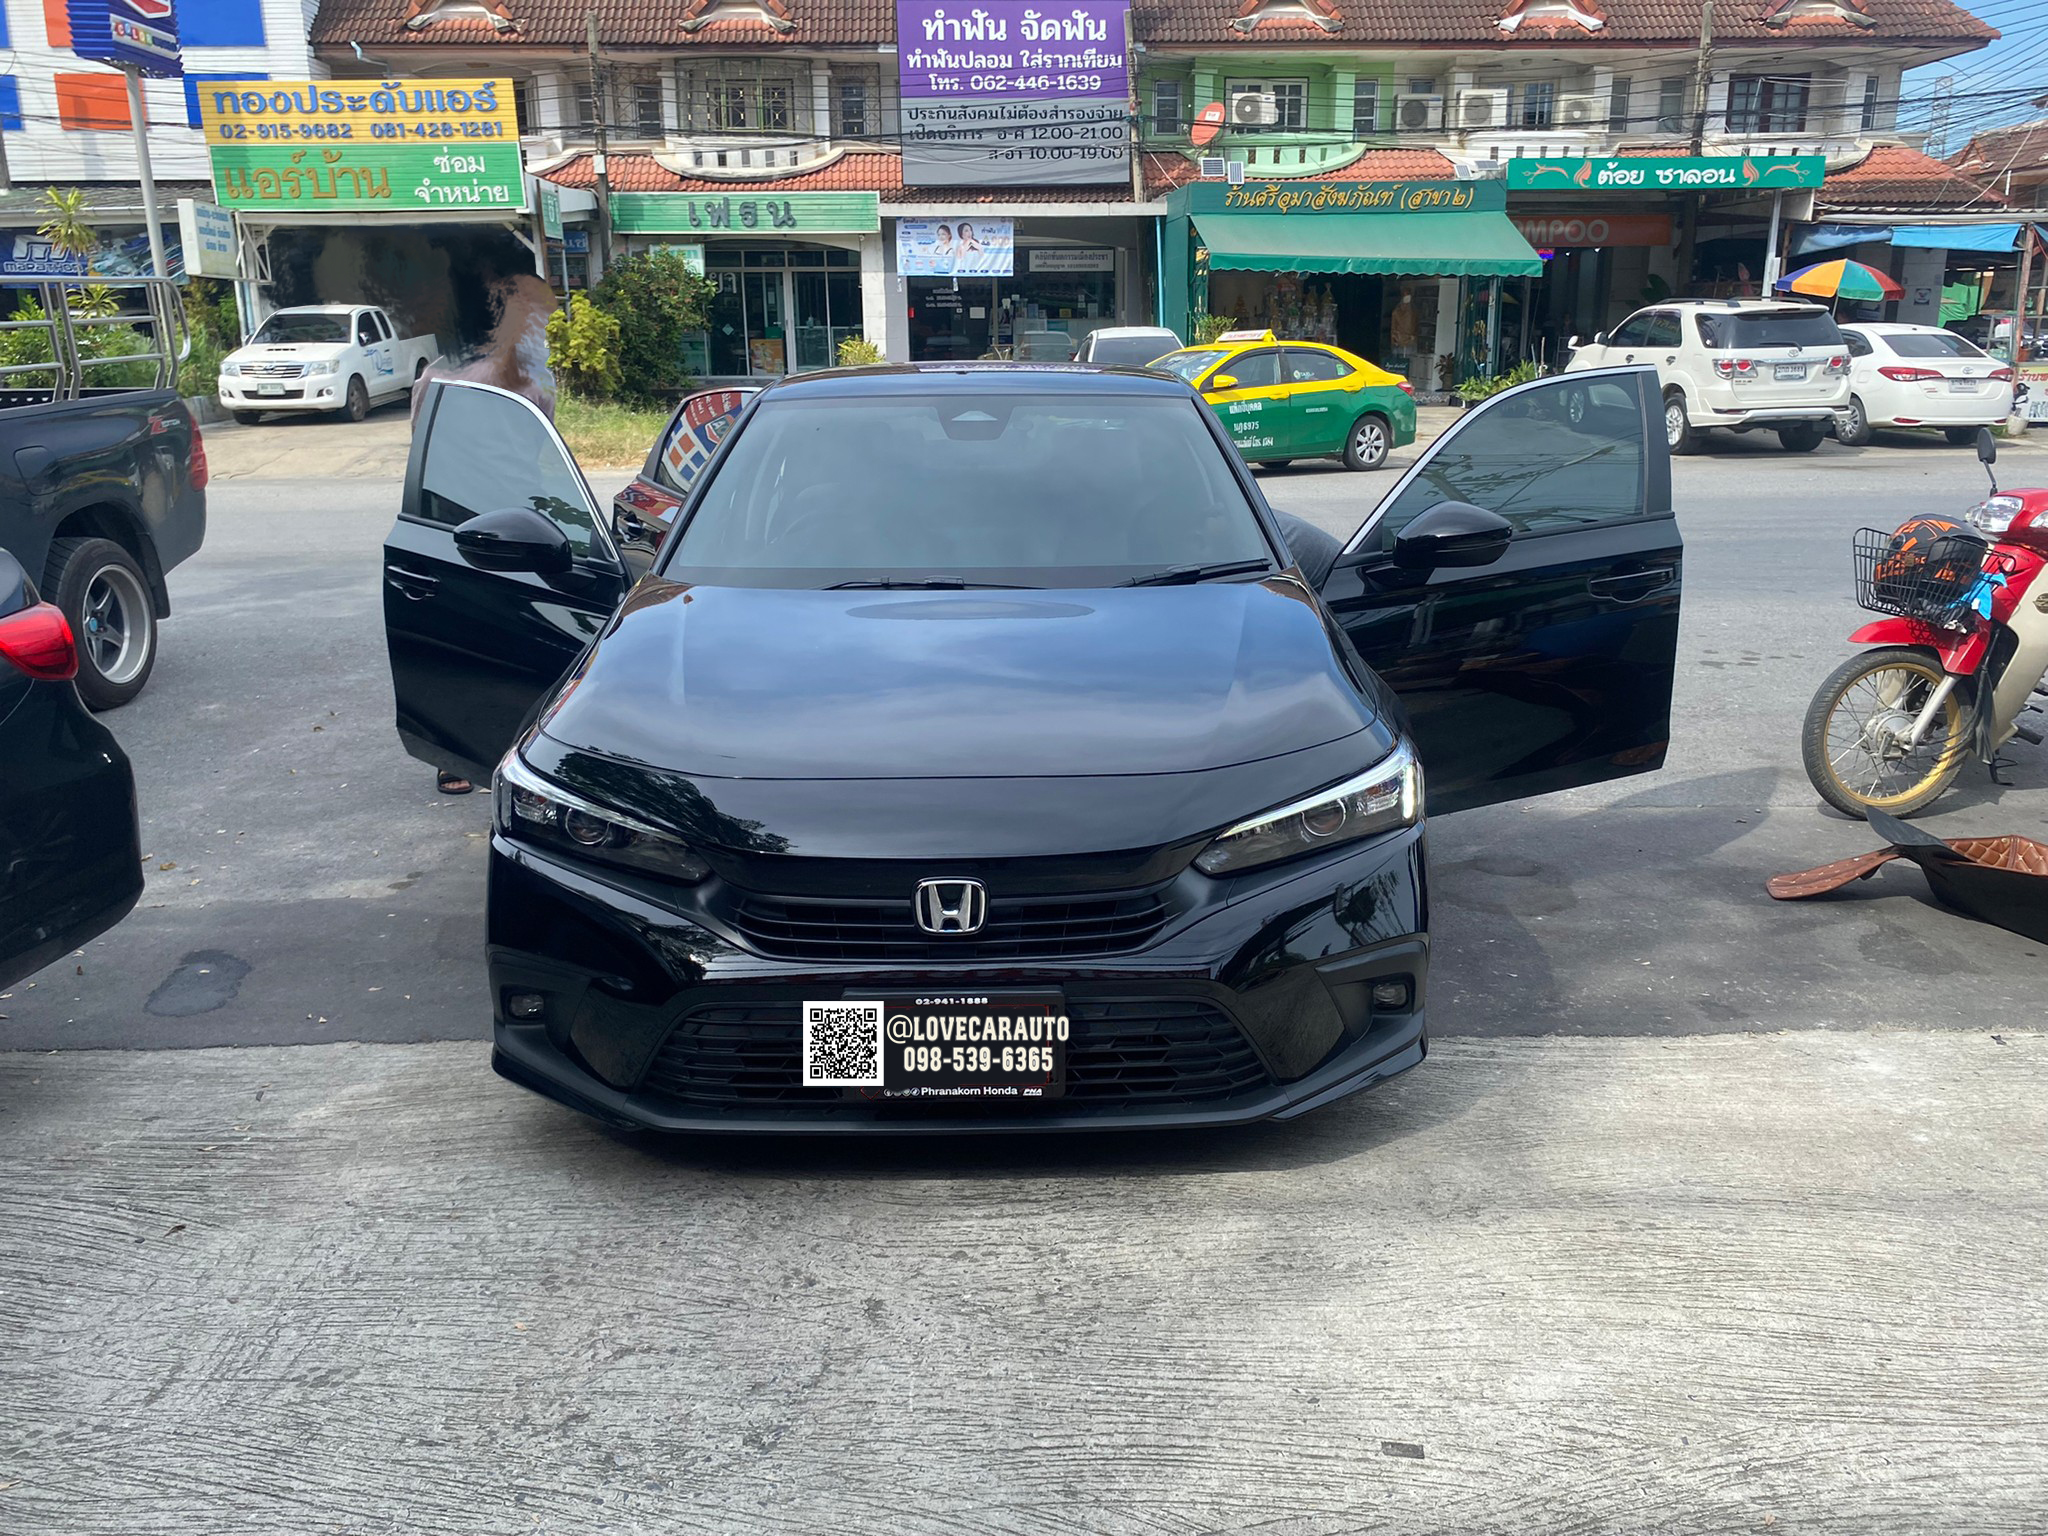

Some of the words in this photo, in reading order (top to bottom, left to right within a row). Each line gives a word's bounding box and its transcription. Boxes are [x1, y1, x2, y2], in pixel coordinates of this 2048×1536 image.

[922, 9, 1007, 41] ทำฟัน
[1020, 9, 1107, 41] จัดฟัน
[906, 48, 1013, 69] ทำฟันปลอม
[1019, 48, 1123, 69] ใส่รากเทียม
[928, 73, 964, 91] โทร.
[970, 75, 1101, 91] 062-446-1639
[212, 81, 500, 115] ทองประดับแอร์
[219, 123, 353, 140] 02-915-9682
[369, 121, 503, 138] 081-428-1281
[1031, 127, 1123, 140] 12.00-21.00
[433, 146, 486, 174] ซ่อม
[224, 149, 392, 199] แอร์บ้าน
[1598, 161, 1645, 185] ต้อย
[1655, 166, 1736, 184] ซาลอน
[414, 178, 508, 204] จำหน่าย
[688, 197, 797, 227] เฟรน
[915, 997, 988, 1005] 02-941-1888
[921, 1086, 981, 1097] Phranakorn
[983, 1086, 1018, 1096] Honda
